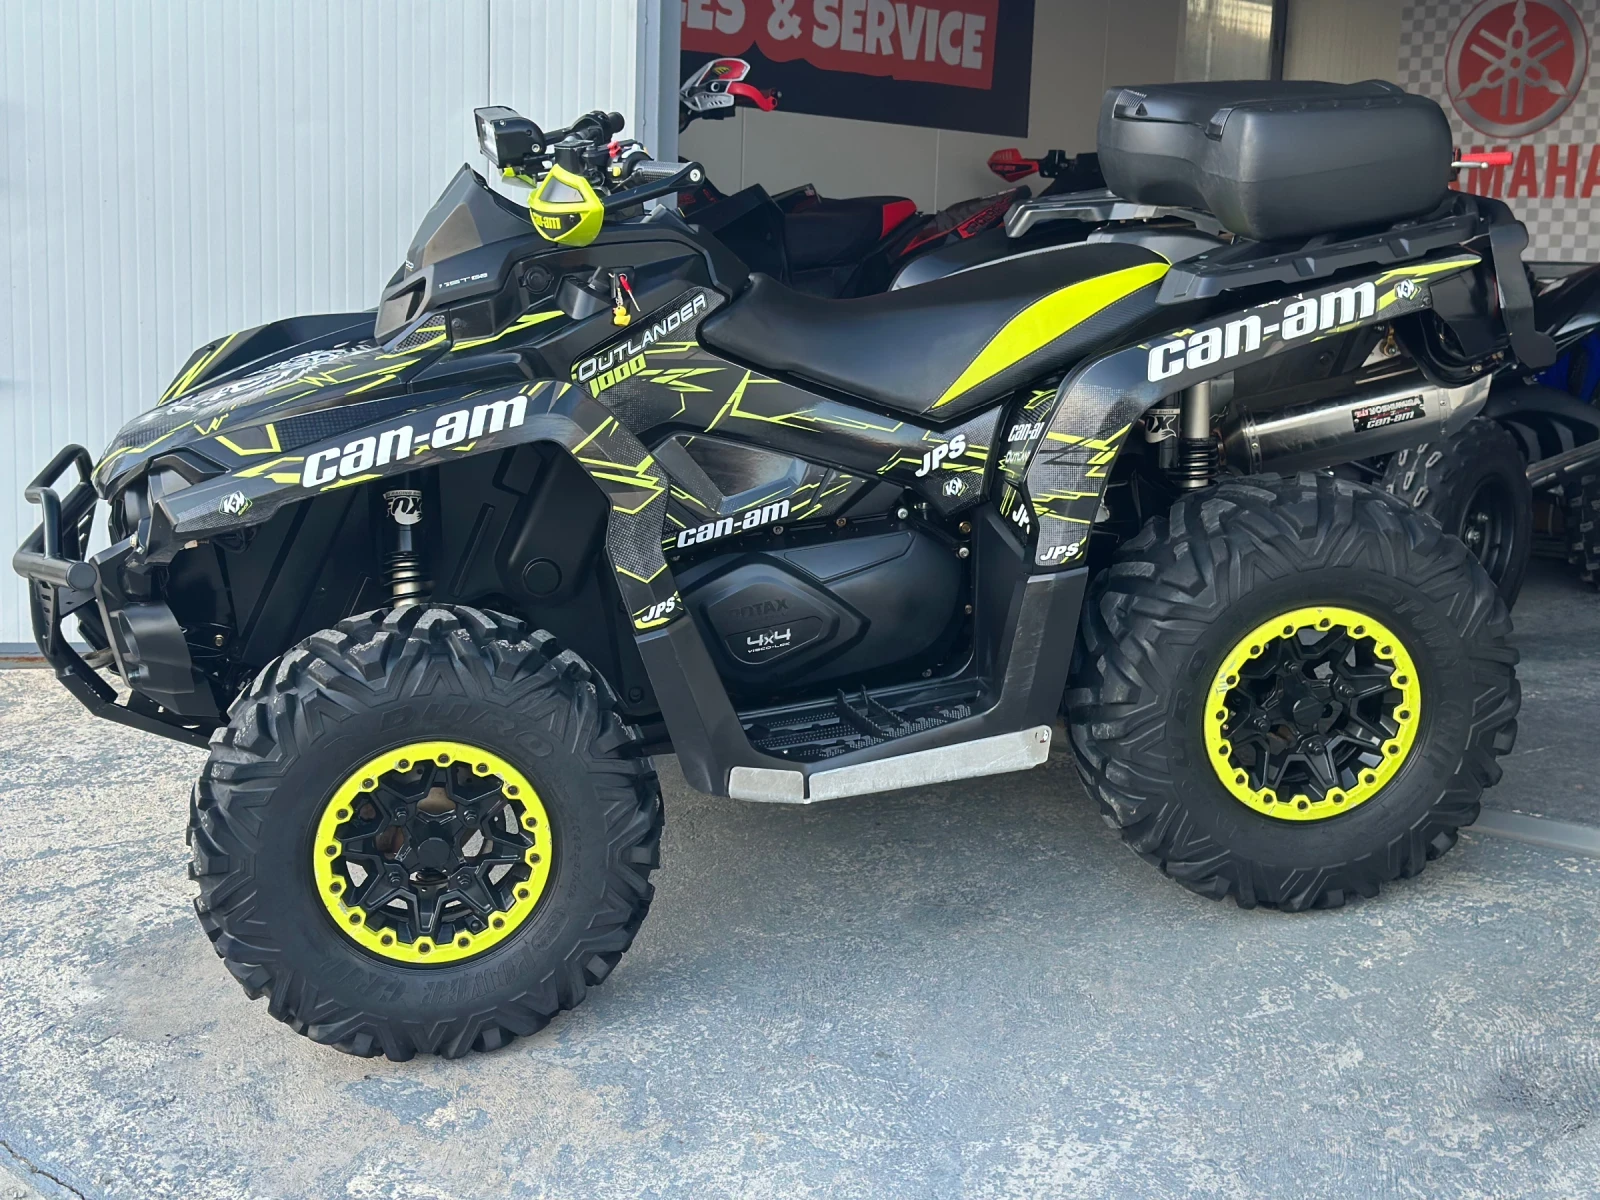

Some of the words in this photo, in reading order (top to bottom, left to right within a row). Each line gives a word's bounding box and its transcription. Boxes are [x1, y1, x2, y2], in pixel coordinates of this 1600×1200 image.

[681, 0, 746, 35] ES
[767, 0, 802, 41] &
[812, 0, 986, 70] SERVICE
[1449, 144, 1600, 199] MAHA
[577, 292, 709, 384] OUTLANDER
[1148, 281, 1377, 383] can-am
[589, 353, 648, 399] 1000
[302, 395, 528, 489] can-am
[1007, 421, 1046, 443] can-a
[1366, 411, 1415, 429] can-am
[914, 433, 967, 478] JPS
[676, 499, 791, 549] can-am
[1039, 542, 1081, 561] JPS
[641, 597, 676, 623] JPS
[746, 628, 792, 646] 4x4
